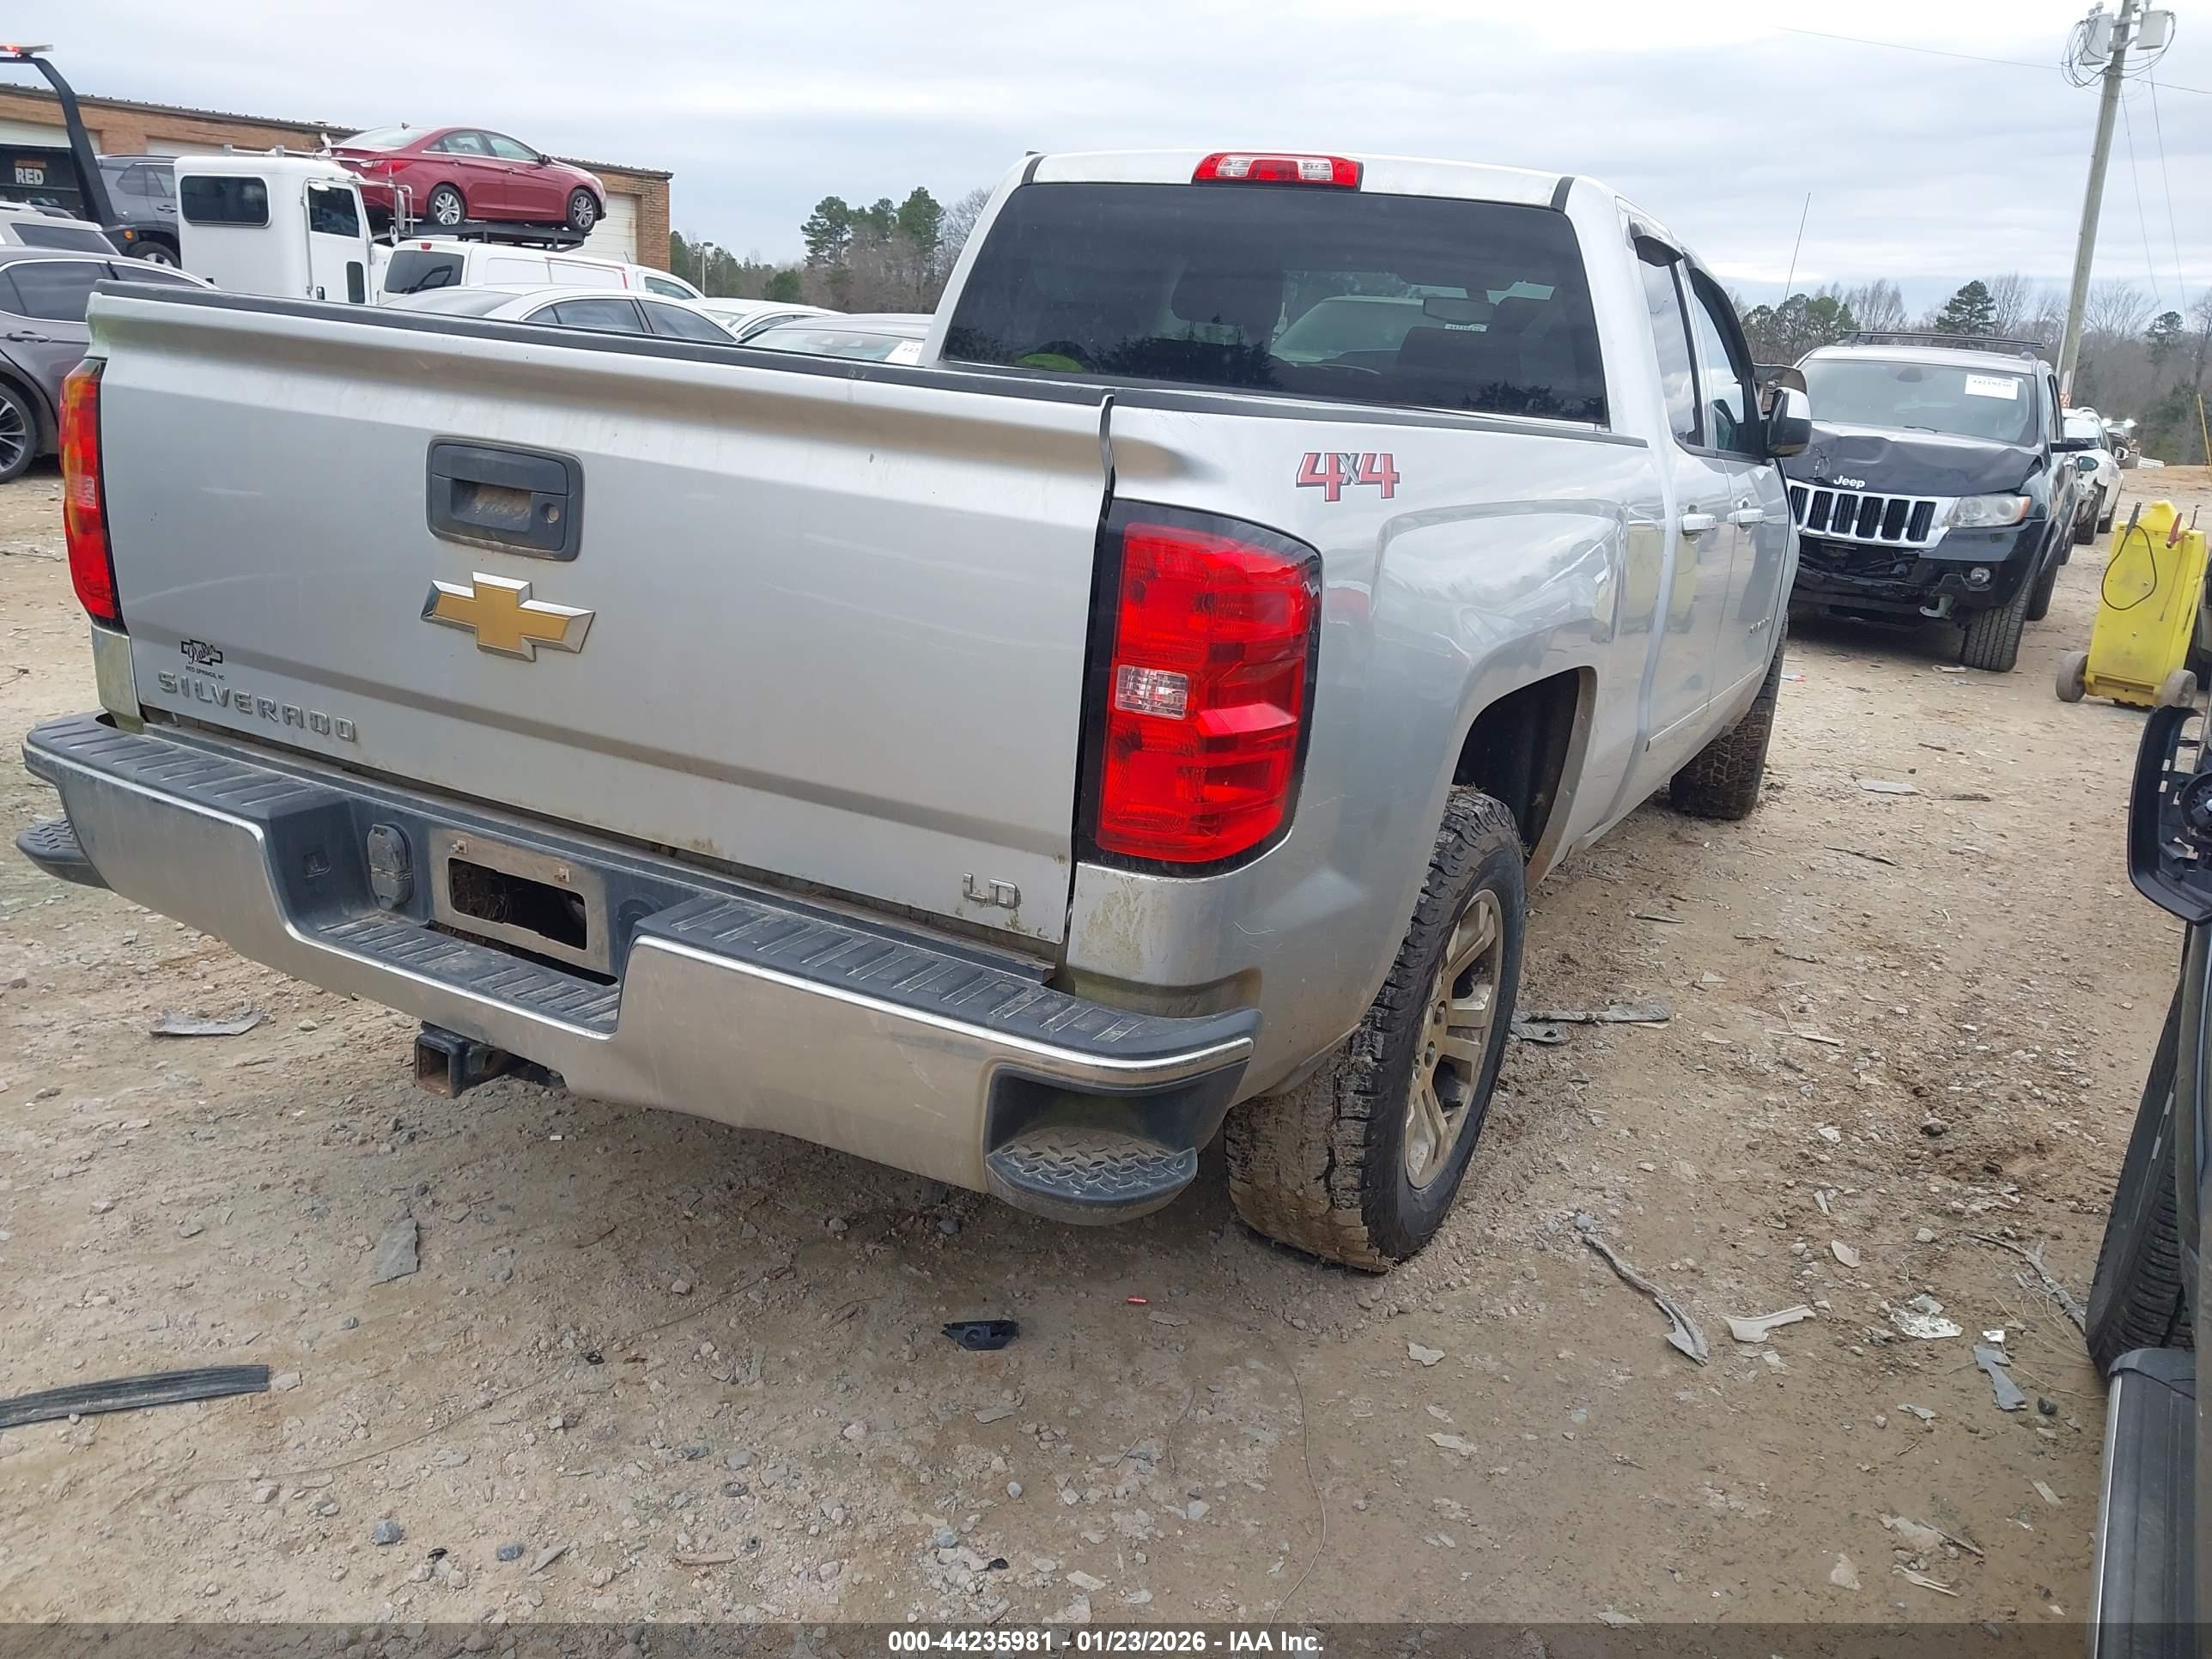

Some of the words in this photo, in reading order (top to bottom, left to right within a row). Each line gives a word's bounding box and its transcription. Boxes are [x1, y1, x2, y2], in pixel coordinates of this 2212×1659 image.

[15, 167, 45, 185] RED
[1832, 475, 1866, 489] Jeep
[158, 671, 356, 742] SILVERADO
[963, 873, 1020, 908] LD
